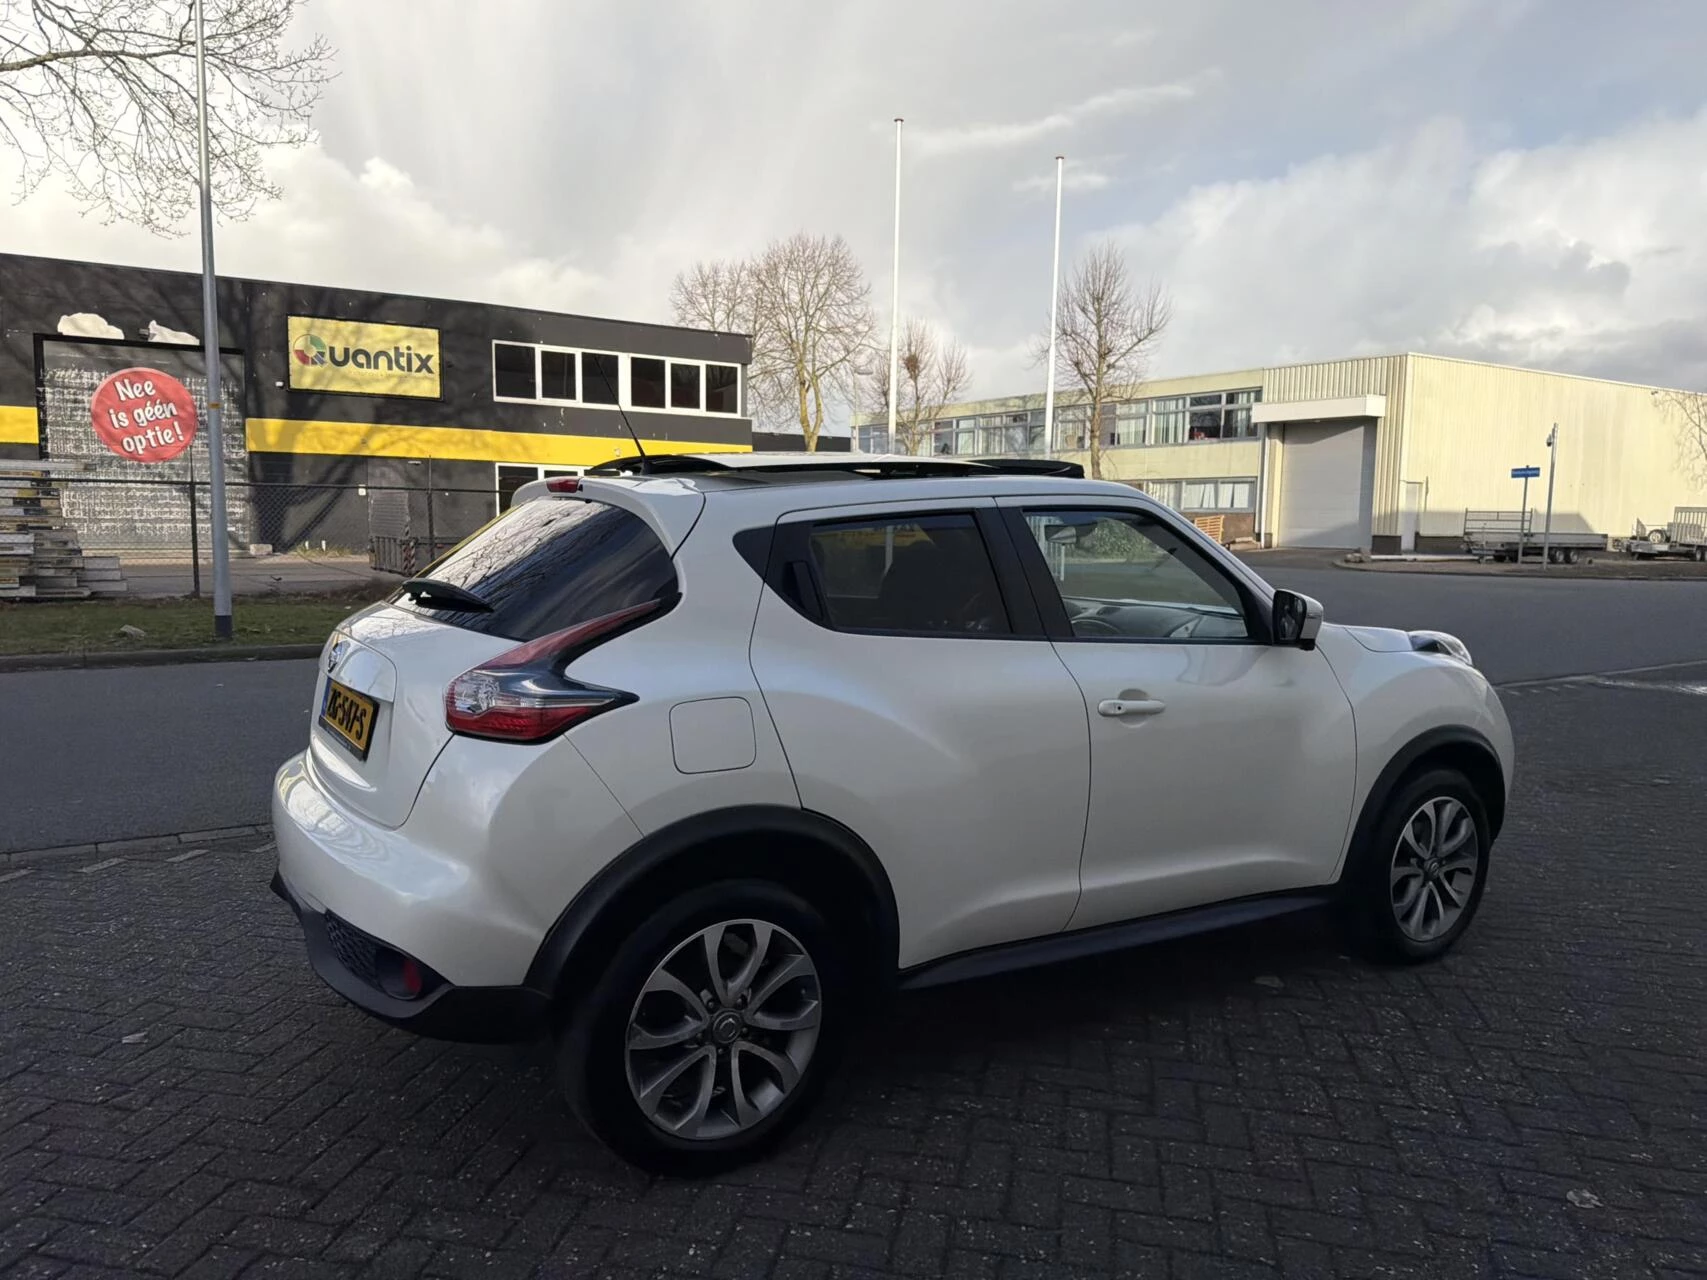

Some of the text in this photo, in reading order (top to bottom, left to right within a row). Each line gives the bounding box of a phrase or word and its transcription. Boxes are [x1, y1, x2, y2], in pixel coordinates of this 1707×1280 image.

[114, 379, 156, 401] Nee
[109, 399, 178, 428] is géén
[122, 421, 184, 454] optie!
